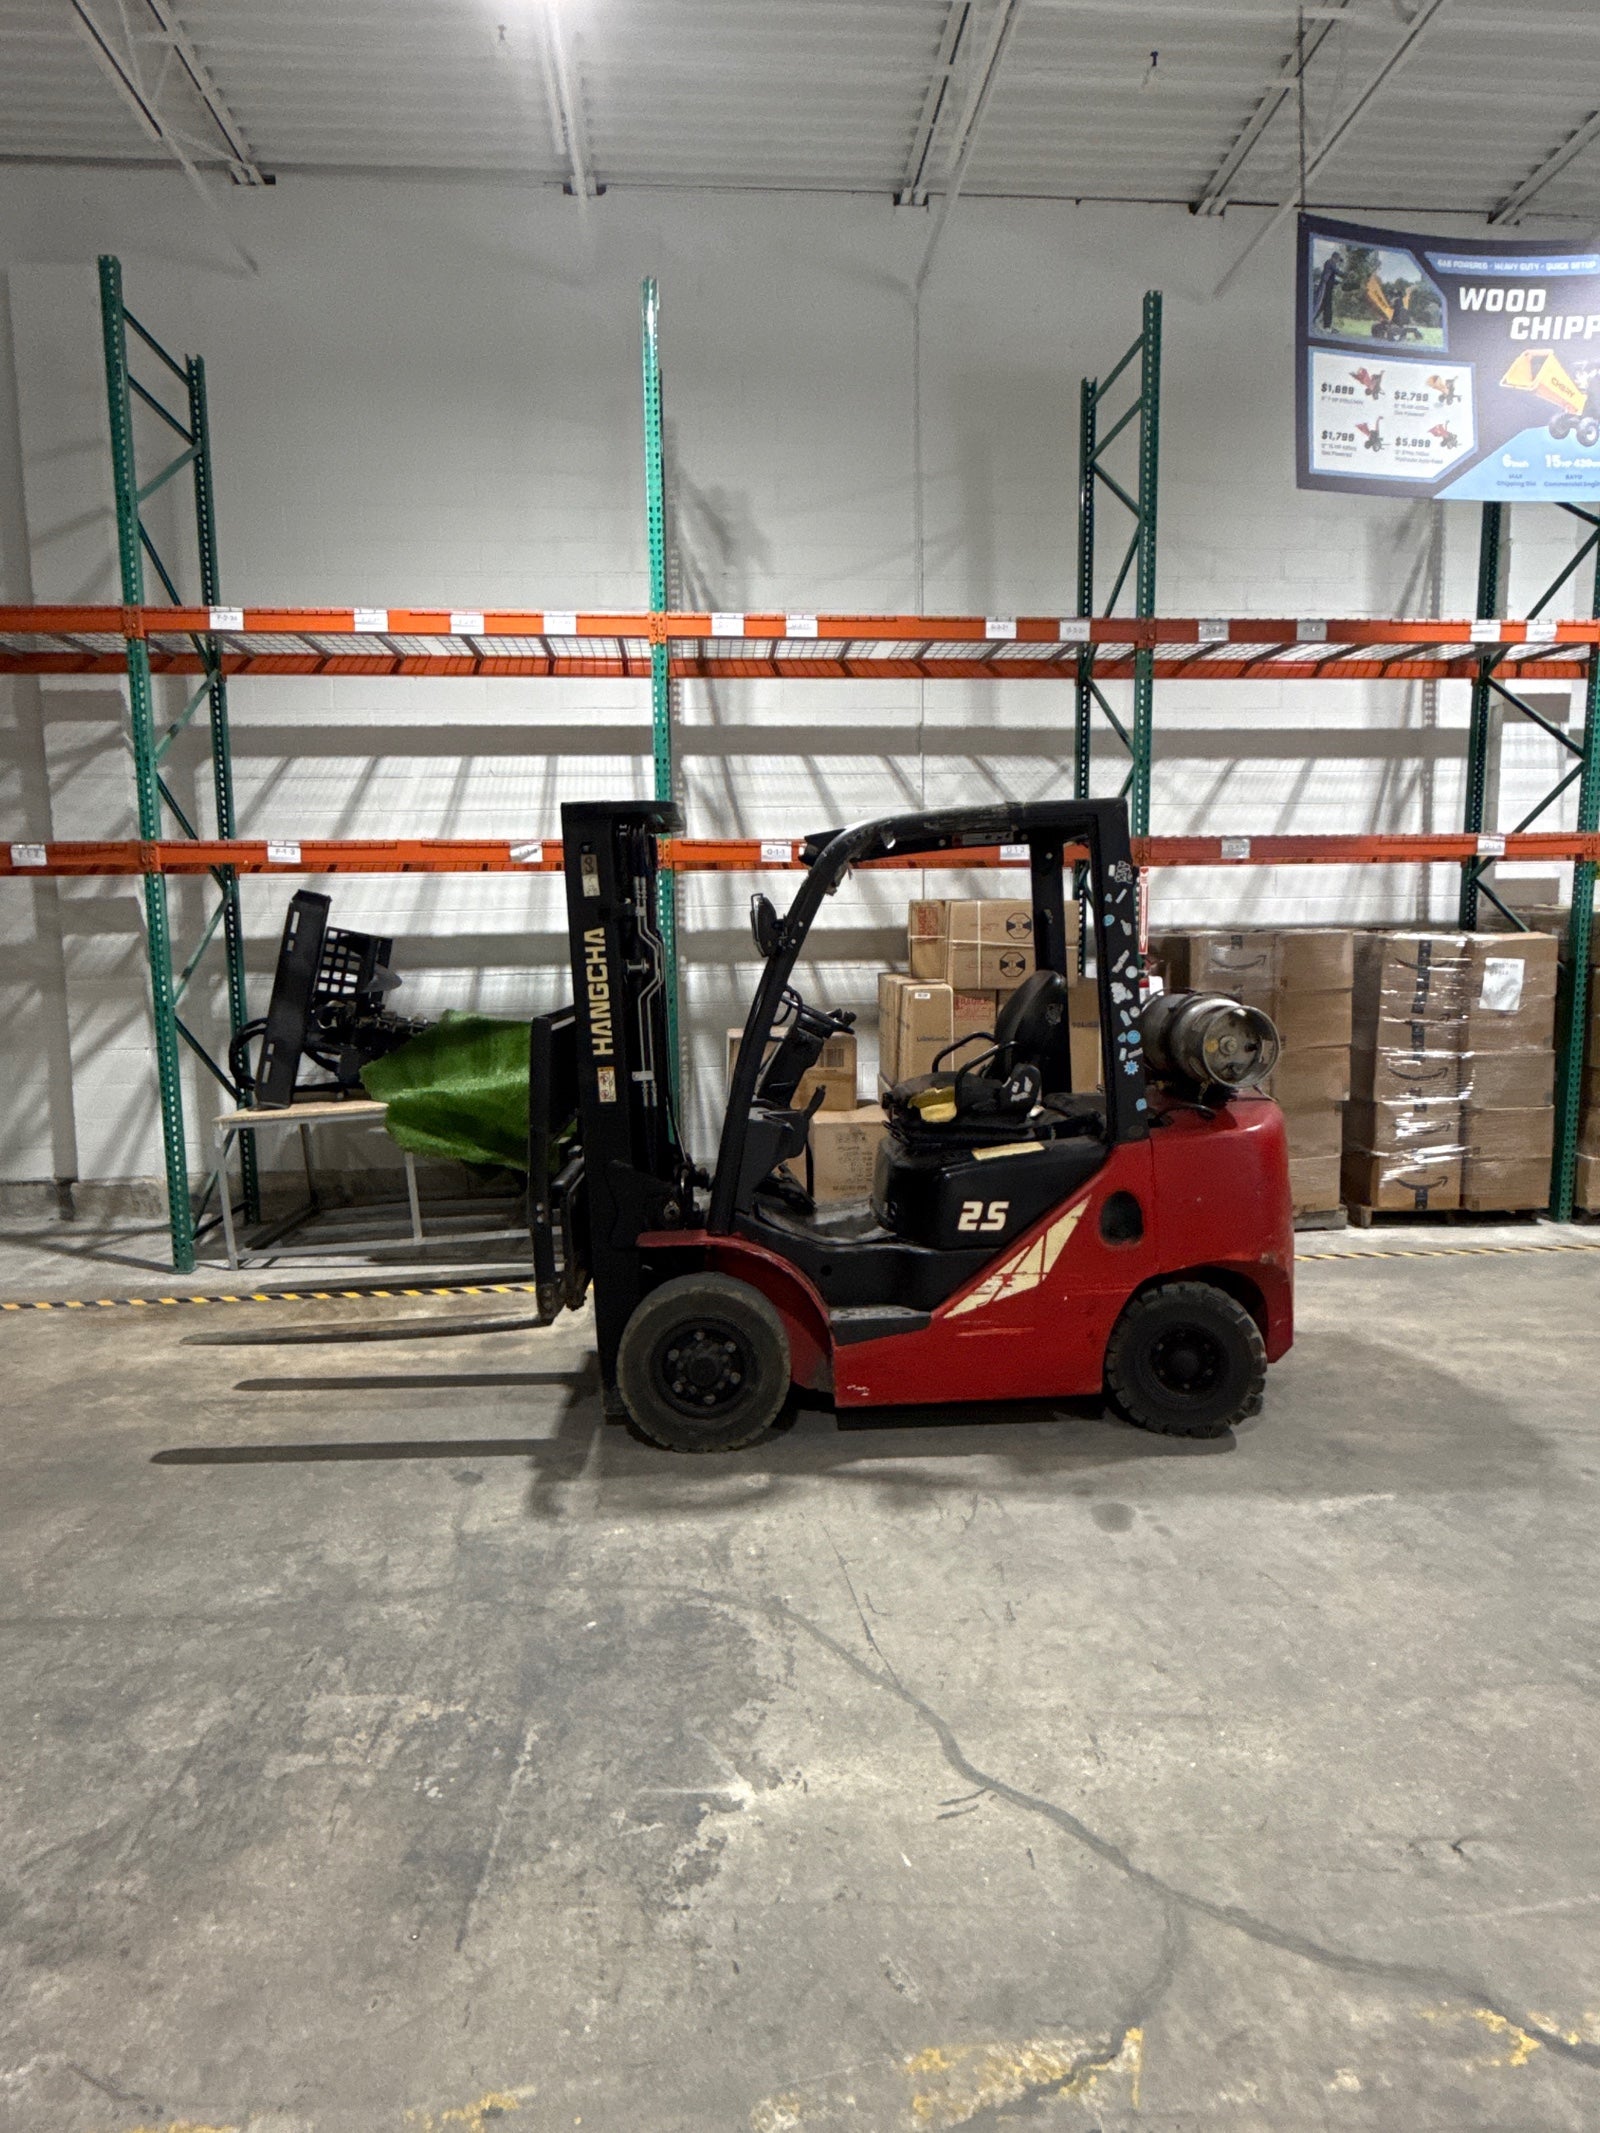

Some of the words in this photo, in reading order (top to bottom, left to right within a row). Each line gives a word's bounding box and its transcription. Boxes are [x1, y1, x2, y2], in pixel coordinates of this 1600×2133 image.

[1459, 287, 1546, 312] WOOD
[583, 926, 614, 1056] HANGCHA
[957, 1200, 1010, 1231] 25
